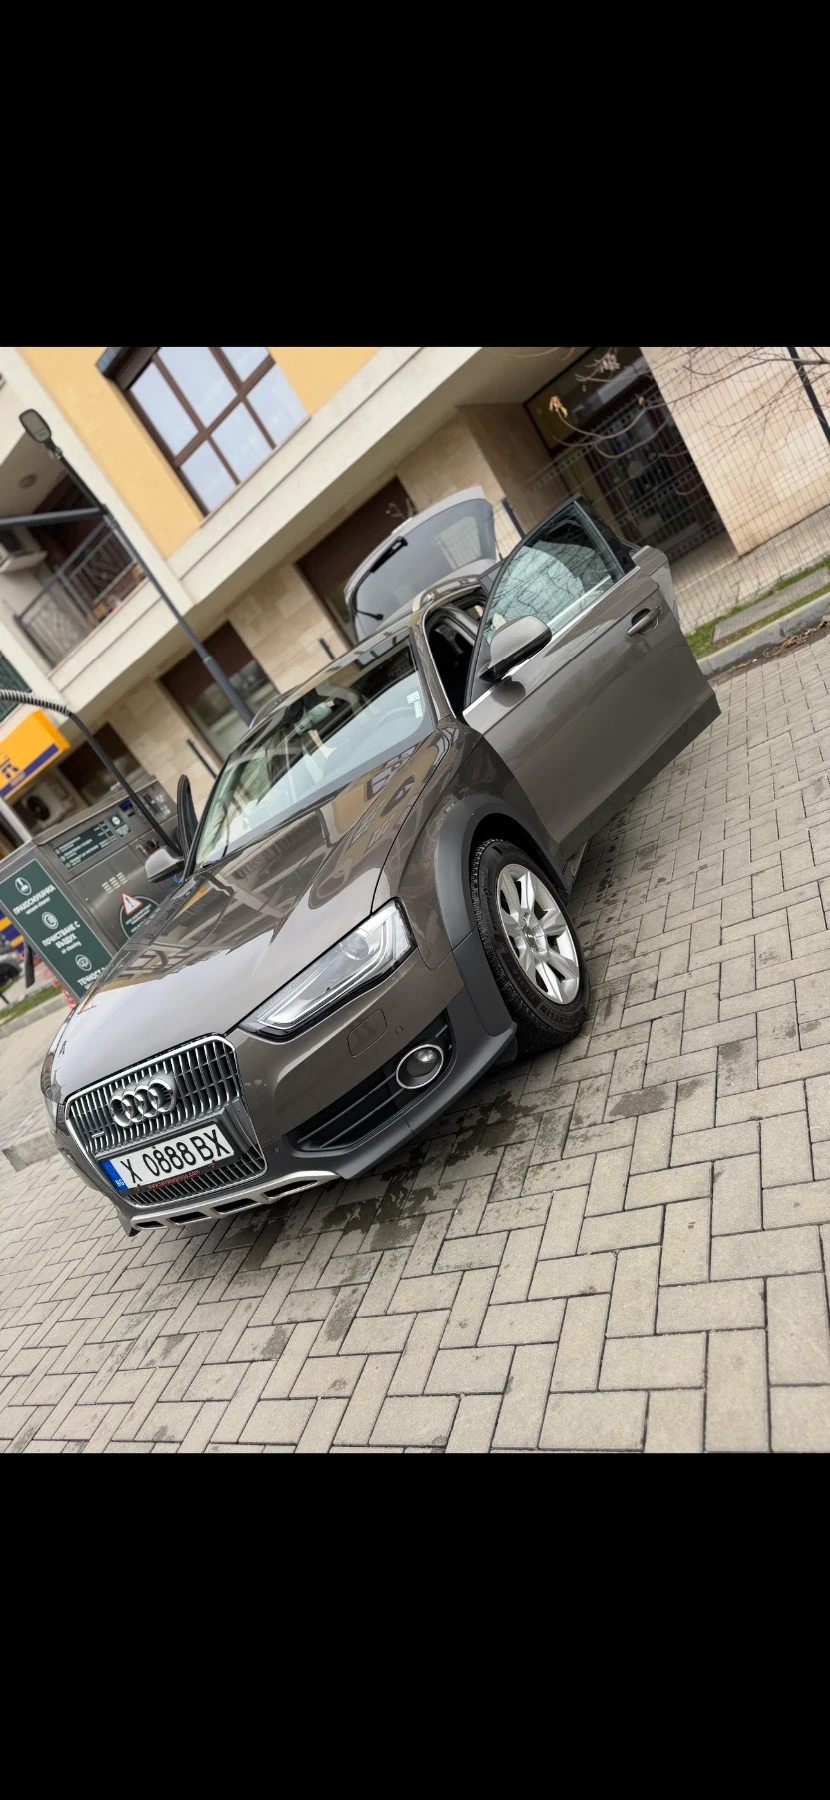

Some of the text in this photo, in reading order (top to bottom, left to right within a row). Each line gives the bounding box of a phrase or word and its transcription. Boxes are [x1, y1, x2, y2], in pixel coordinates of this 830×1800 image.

[13, 884, 56, 915] ПРАХОСМУКАЧКА
[42, 923, 76, 947] ПОЧИСТВАНЕ
[55, 933, 77, 949] ВЪЗДУХ
[120, 1129, 230, 1183] X 0888 BX
[115, 1178, 125, 1187] BG
